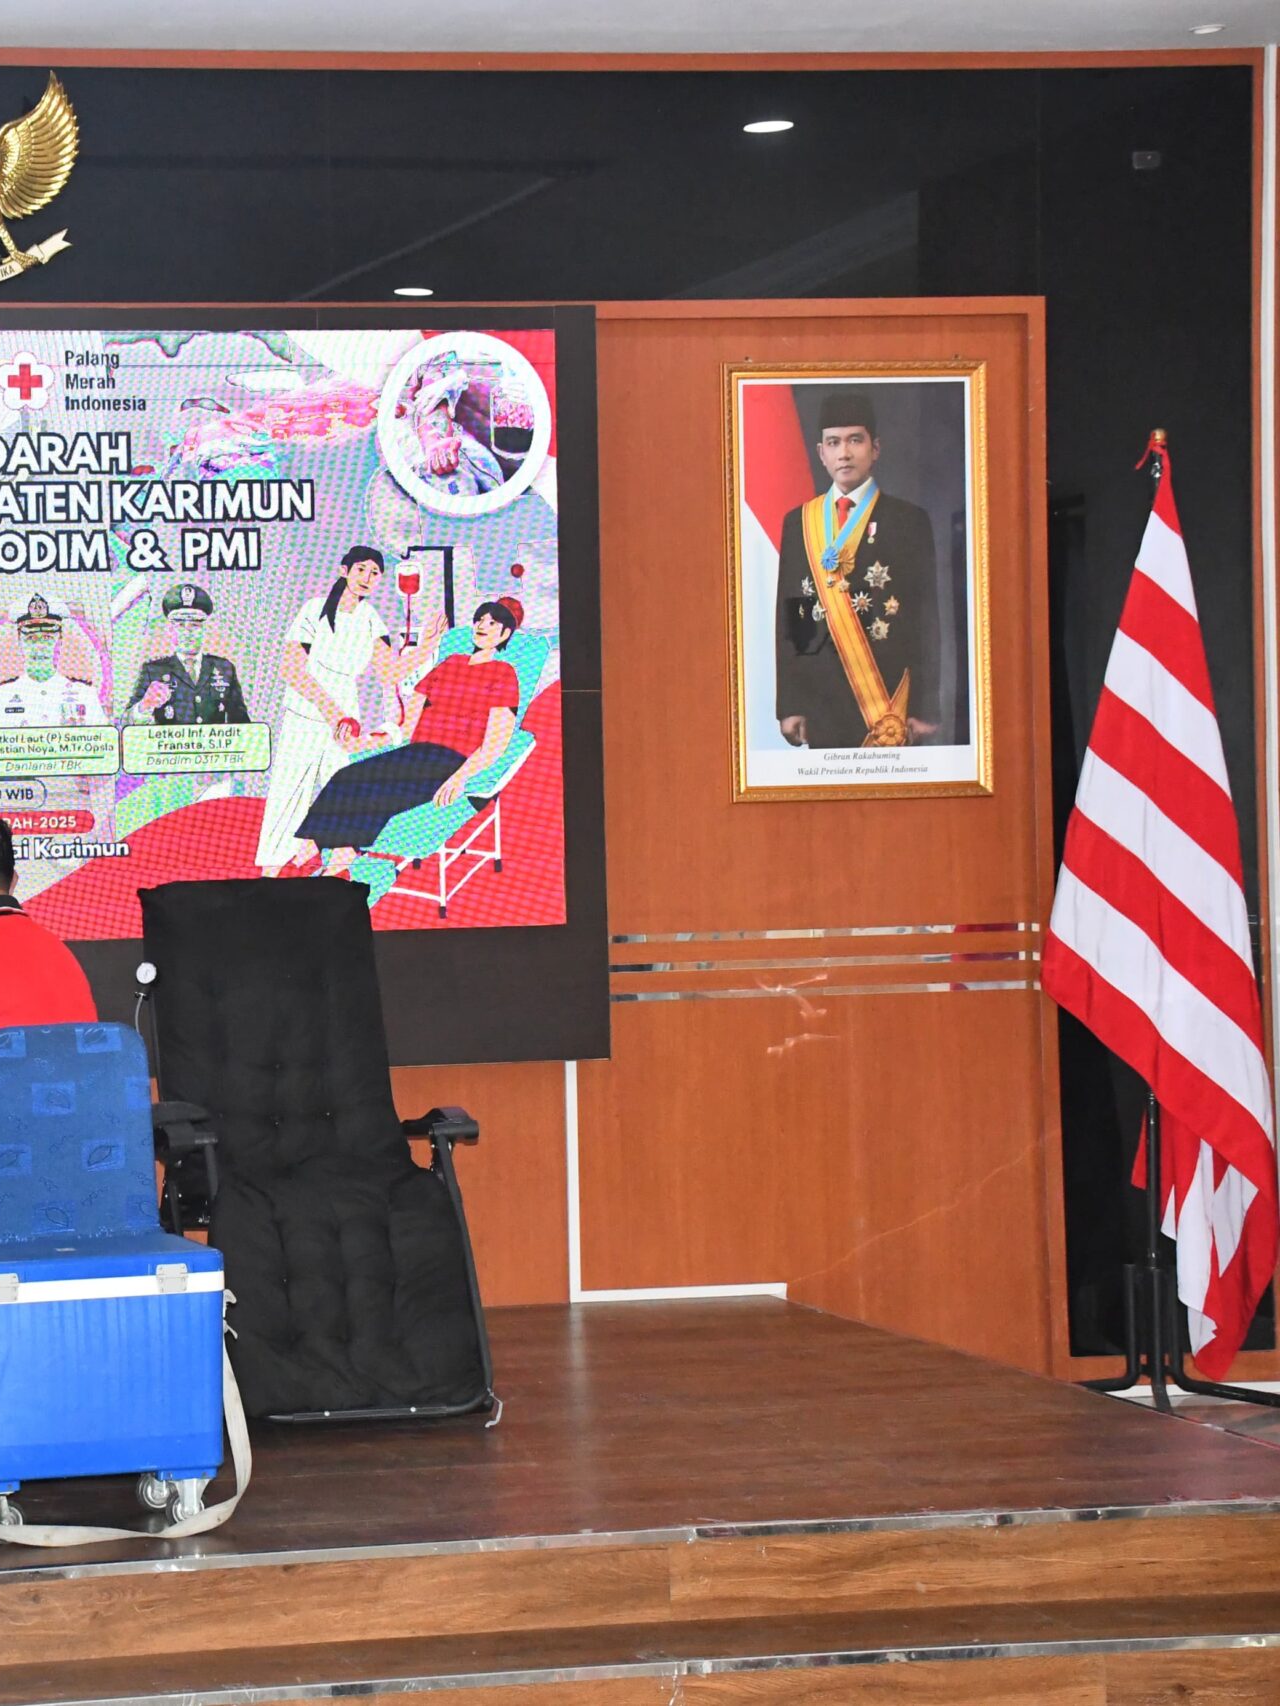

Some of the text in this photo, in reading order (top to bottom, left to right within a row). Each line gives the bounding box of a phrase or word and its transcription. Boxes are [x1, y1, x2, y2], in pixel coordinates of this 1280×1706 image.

[0, 265, 16, 278] IKA
[64, 350, 120, 369] Palang
[65, 373, 116, 390] Merah
[64, 395, 147, 411] Indonesia
[110, 478, 315, 522] KARIMUN
[127, 530, 175, 573] &
[181, 529, 262, 571] PMI
[20, 734, 44, 743] Laut
[46, 732, 62, 744] (P)
[64, 732, 102, 742] Samuel
[148, 727, 241, 739] Letkol Inf. Andit
[208, 738, 232, 749] S.I.P
[28, 745, 57, 755] Noya,
[823, 750, 901, 762] Gibran Rakabuming
[60, 760, 82, 770] TBK
[146, 754, 245, 766] Dandim 0317 TBK
[797, 763, 928, 776] Wakil Presiden Republik Indonesia
[6, 788, 34, 800] WIB
[34, 837, 130, 859] Karimun
